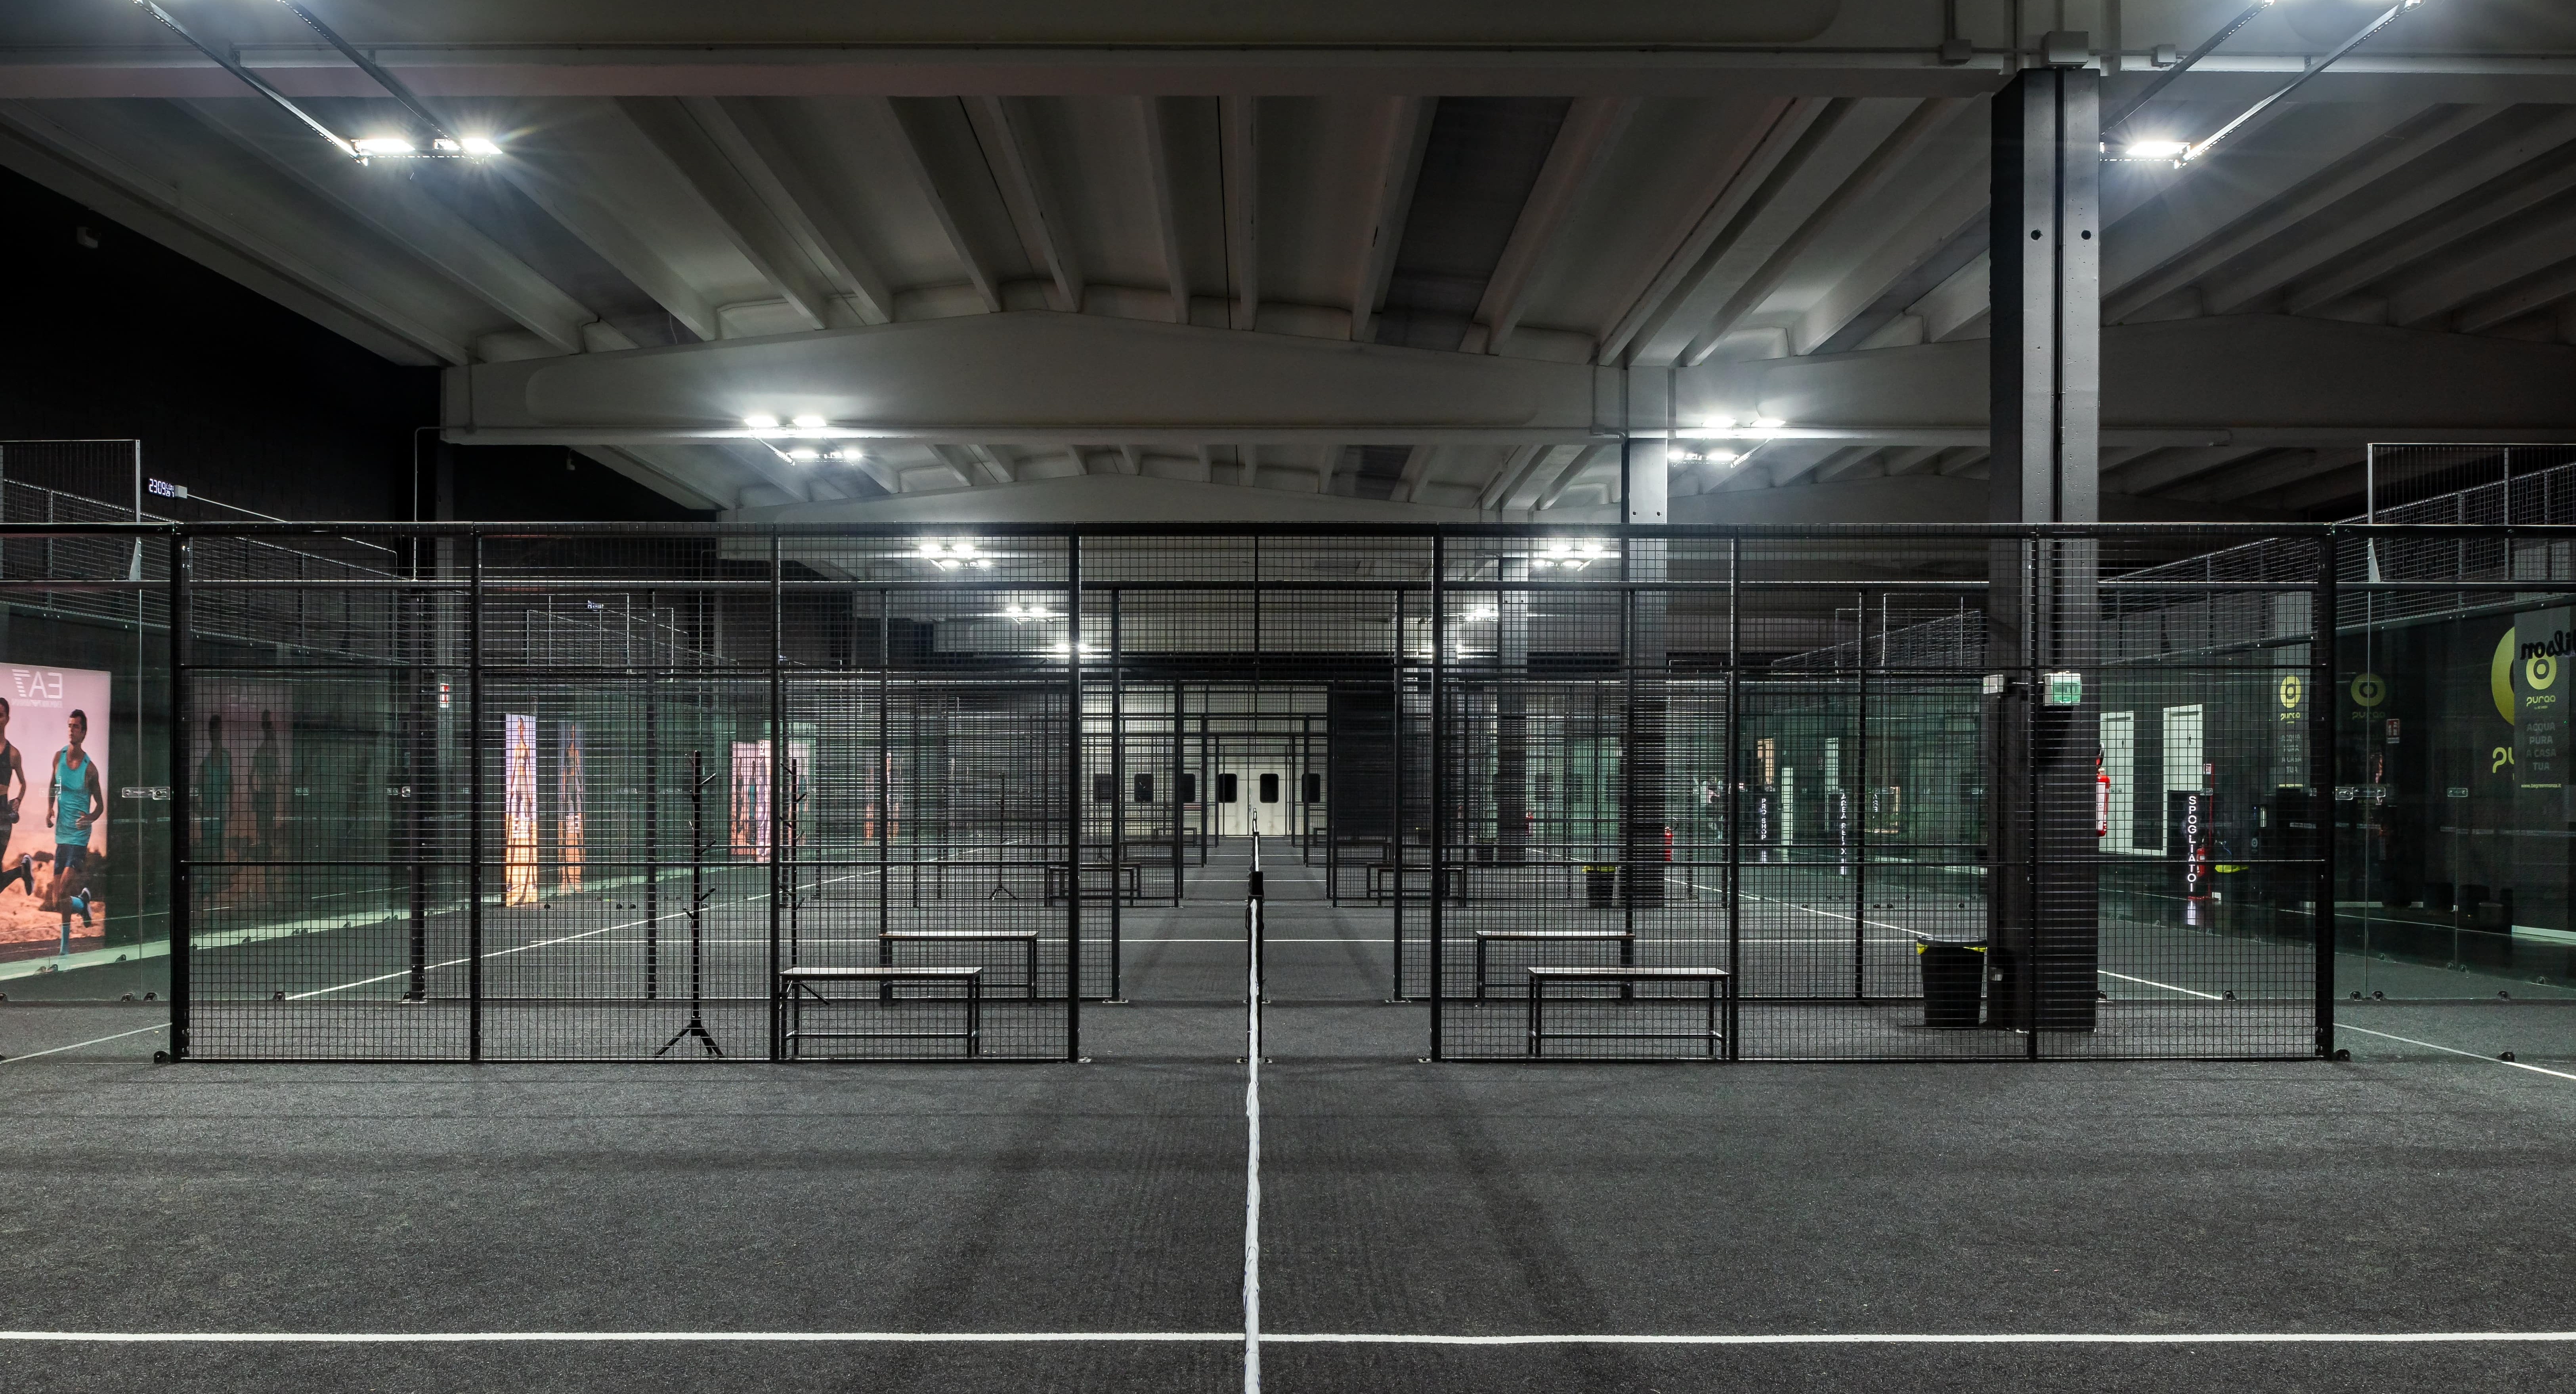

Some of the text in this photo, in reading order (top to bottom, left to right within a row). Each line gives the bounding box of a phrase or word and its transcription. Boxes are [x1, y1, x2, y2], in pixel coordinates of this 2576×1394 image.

[2526, 722, 2555, 732] ACQUA
[2529, 736, 2553, 744] PURA
[2534, 749, 2556, 757] CASA
[2532, 762, 2549, 771] TUA
[2187, 795, 2197, 892] SPOGLIATOI
